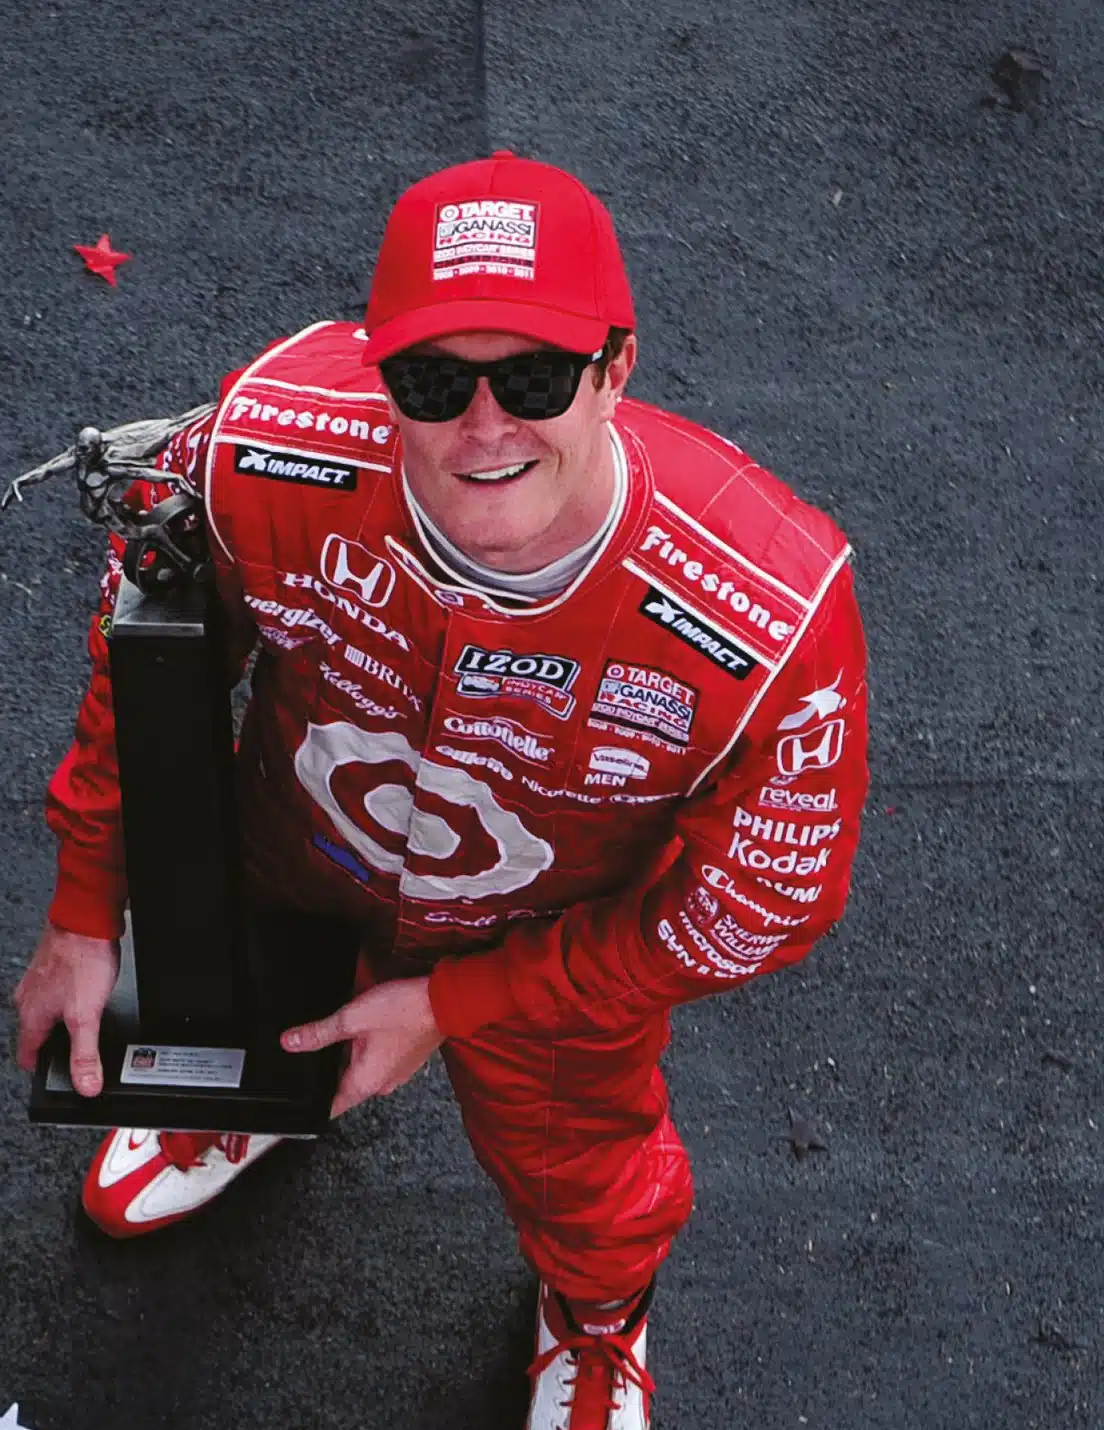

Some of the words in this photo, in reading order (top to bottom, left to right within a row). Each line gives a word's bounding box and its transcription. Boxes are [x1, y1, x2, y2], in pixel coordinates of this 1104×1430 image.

[228, 396, 392, 445] Firestone
[639, 525, 795, 641] Firestone
[283, 572, 410, 652] HONDA
[466, 651, 565, 680] IZOD
[627, 666, 695, 705] TARGET
[584, 773, 627, 787] MEN
[759, 786, 837, 812] reveal
[732, 805, 843, 847] PHILIPS
[727, 831, 832, 876] Kodak
